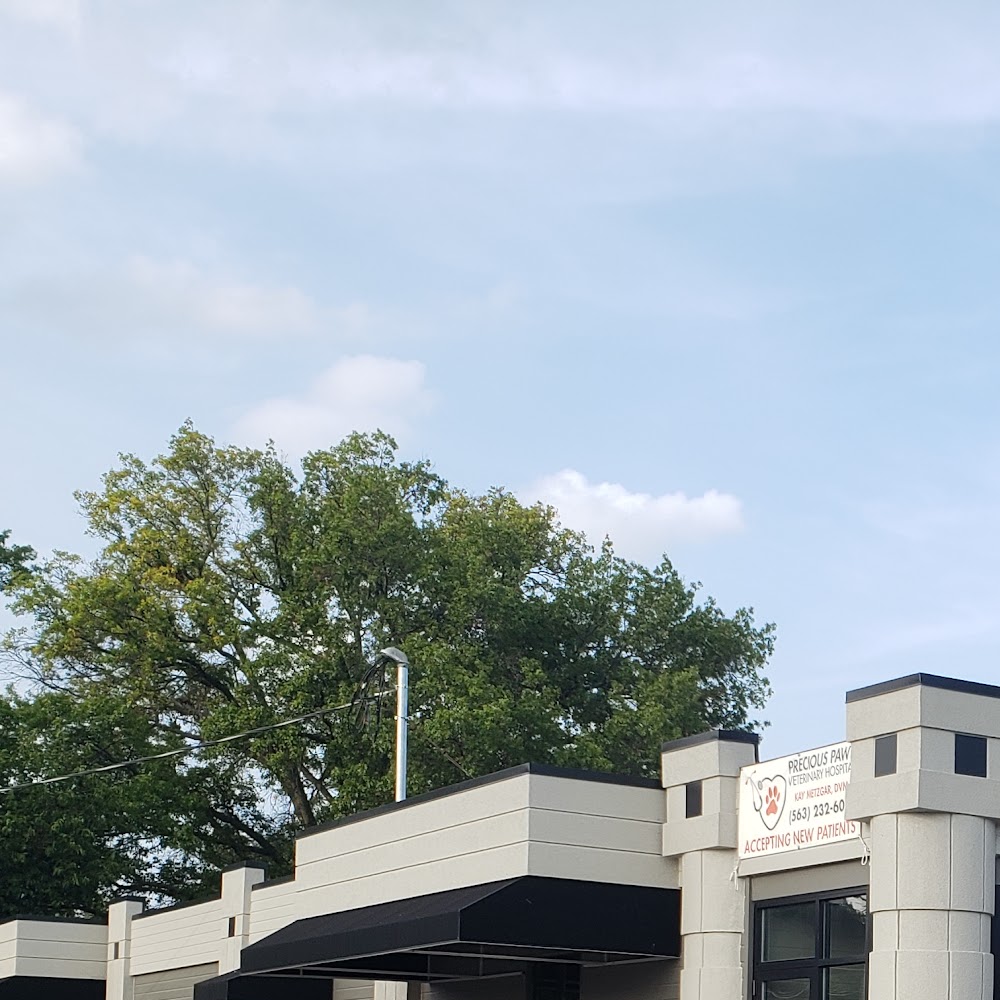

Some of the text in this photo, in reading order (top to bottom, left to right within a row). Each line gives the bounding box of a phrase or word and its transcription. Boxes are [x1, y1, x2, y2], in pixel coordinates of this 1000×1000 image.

[788, 745, 852, 774] PRECIOUS PAW
[788, 762, 852, 787] VETERINARY HOSPITA
[794, 791, 805, 802] KAY
[789, 799, 845, 825] (563) 232-60
[744, 820, 856, 854] ACCEPTING NEW PATIENTS
